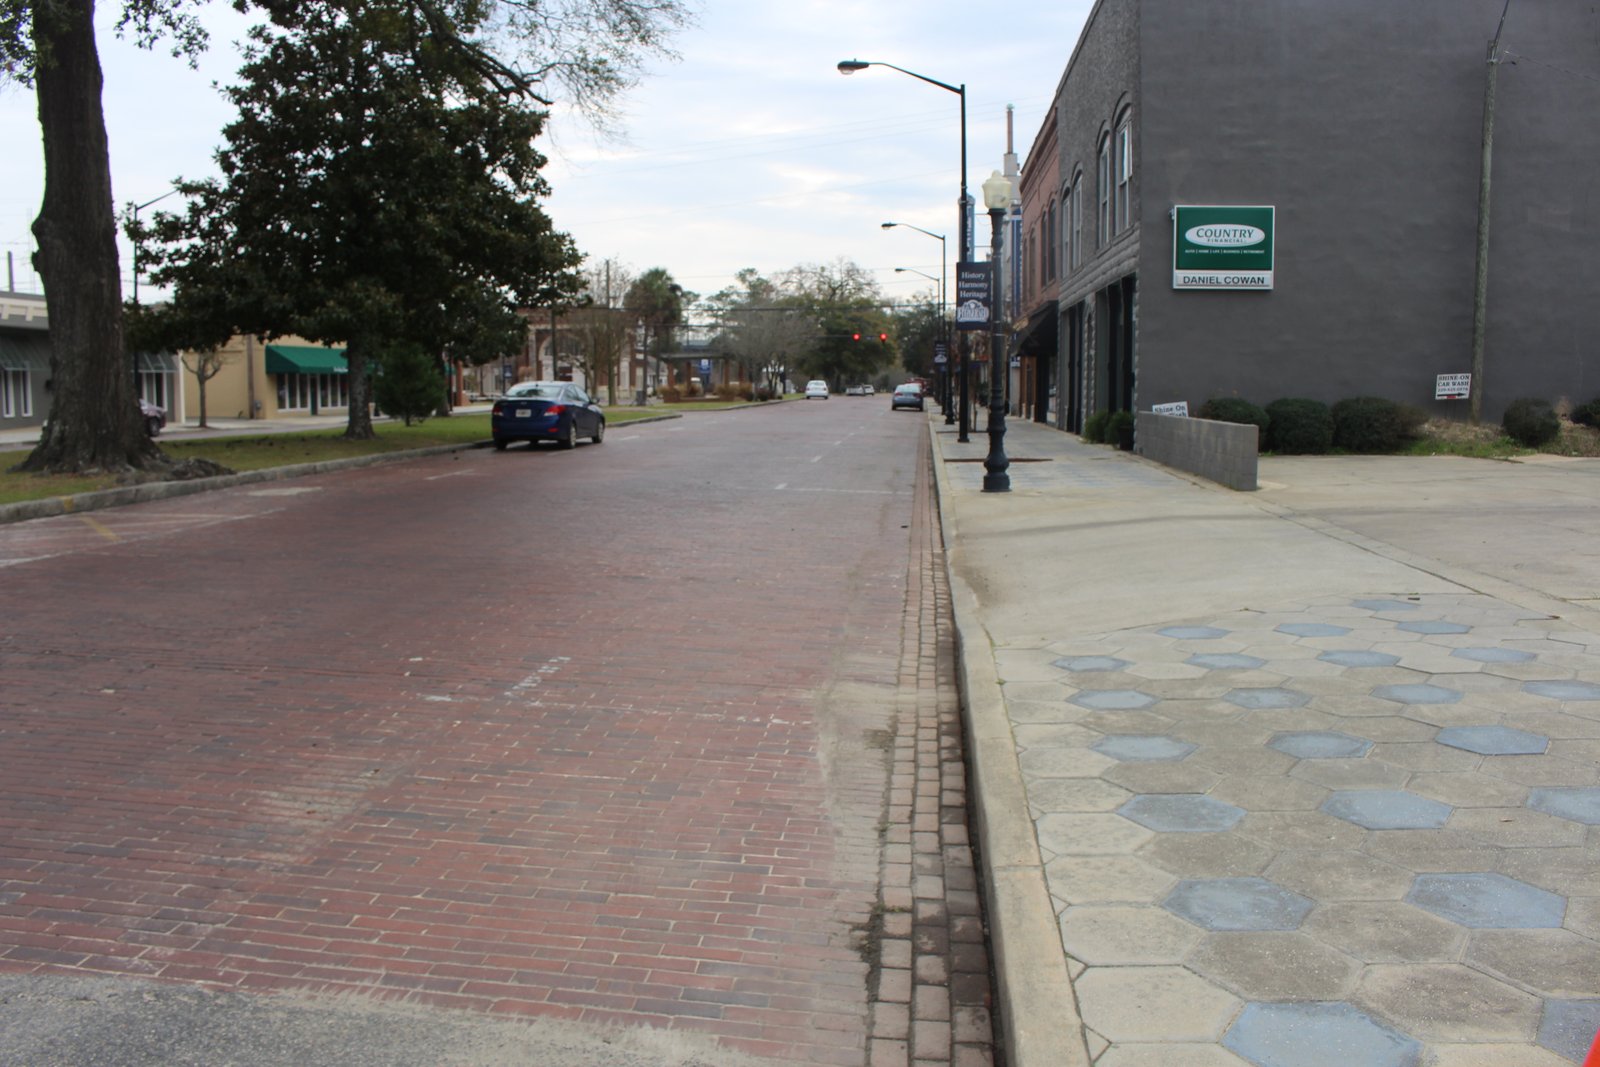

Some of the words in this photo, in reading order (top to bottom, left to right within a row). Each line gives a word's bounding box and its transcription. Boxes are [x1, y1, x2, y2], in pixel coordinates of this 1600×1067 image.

[1196, 228, 1254, 238] COUNTRY
[961, 272, 985, 280] History
[1183, 276, 1222, 284] DANIEL
[1224, 276, 1265, 284] COWAN
[958, 281, 988, 290] Harmony
[960, 290, 988, 299] Heritage
